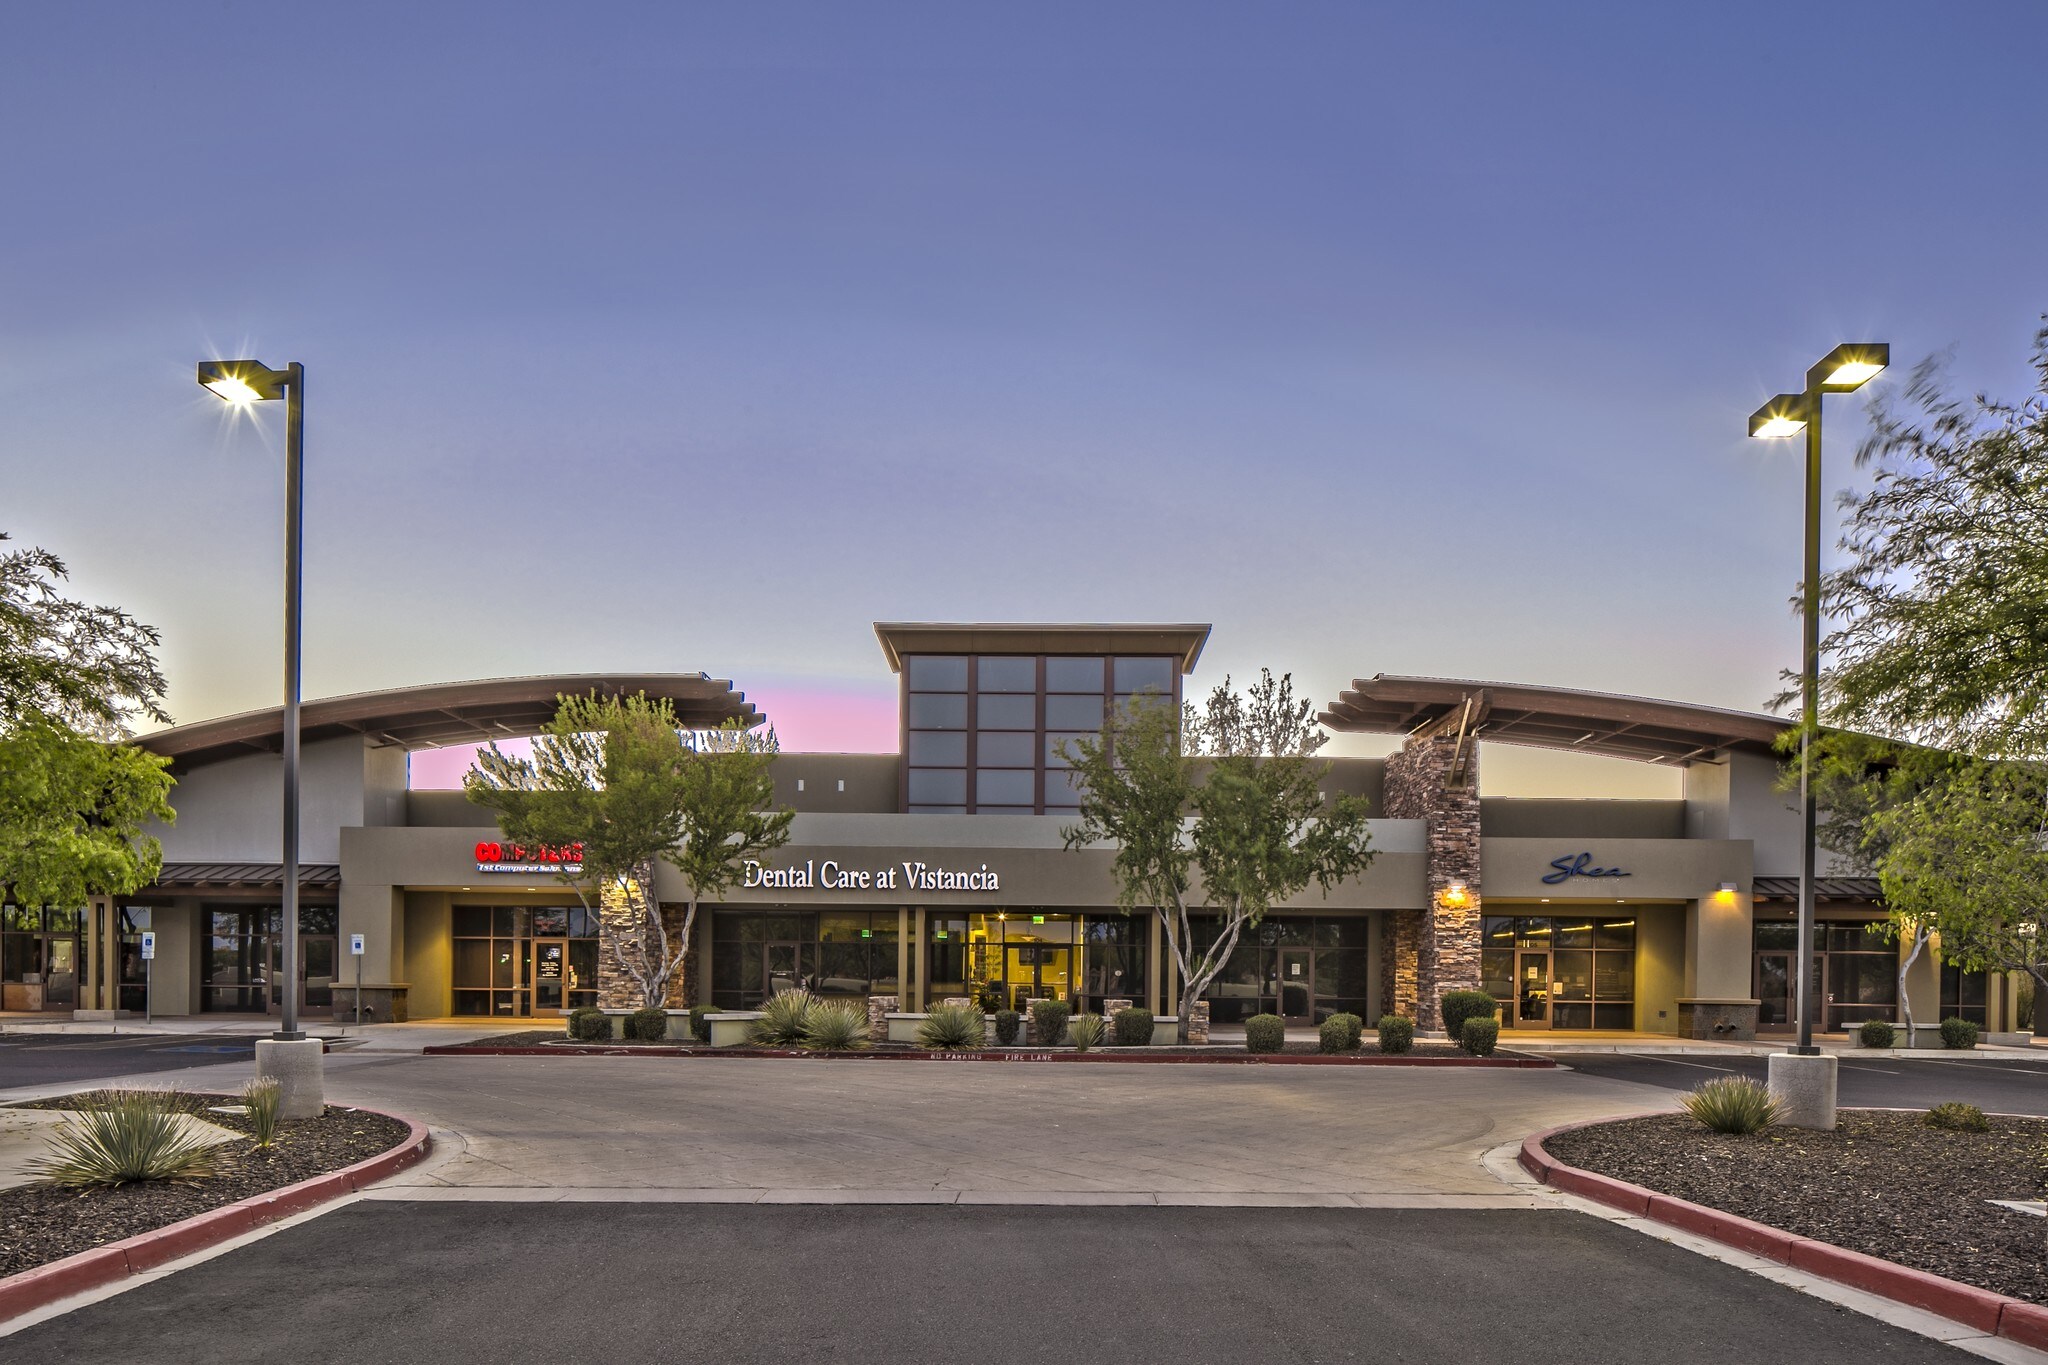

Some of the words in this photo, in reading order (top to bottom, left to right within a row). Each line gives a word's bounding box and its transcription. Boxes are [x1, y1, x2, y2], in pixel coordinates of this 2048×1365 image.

[495, 864, 539, 872] Computer
[540, 864, 582, 872] Soluons
[743, 860, 814, 888] Dental
[820, 860, 870, 889] Care
[876, 867, 897, 889] at
[902, 862, 999, 890] Vistancia
[1542, 852, 1632, 884] Shea
[946, 1053, 982, 1061] PARKING
